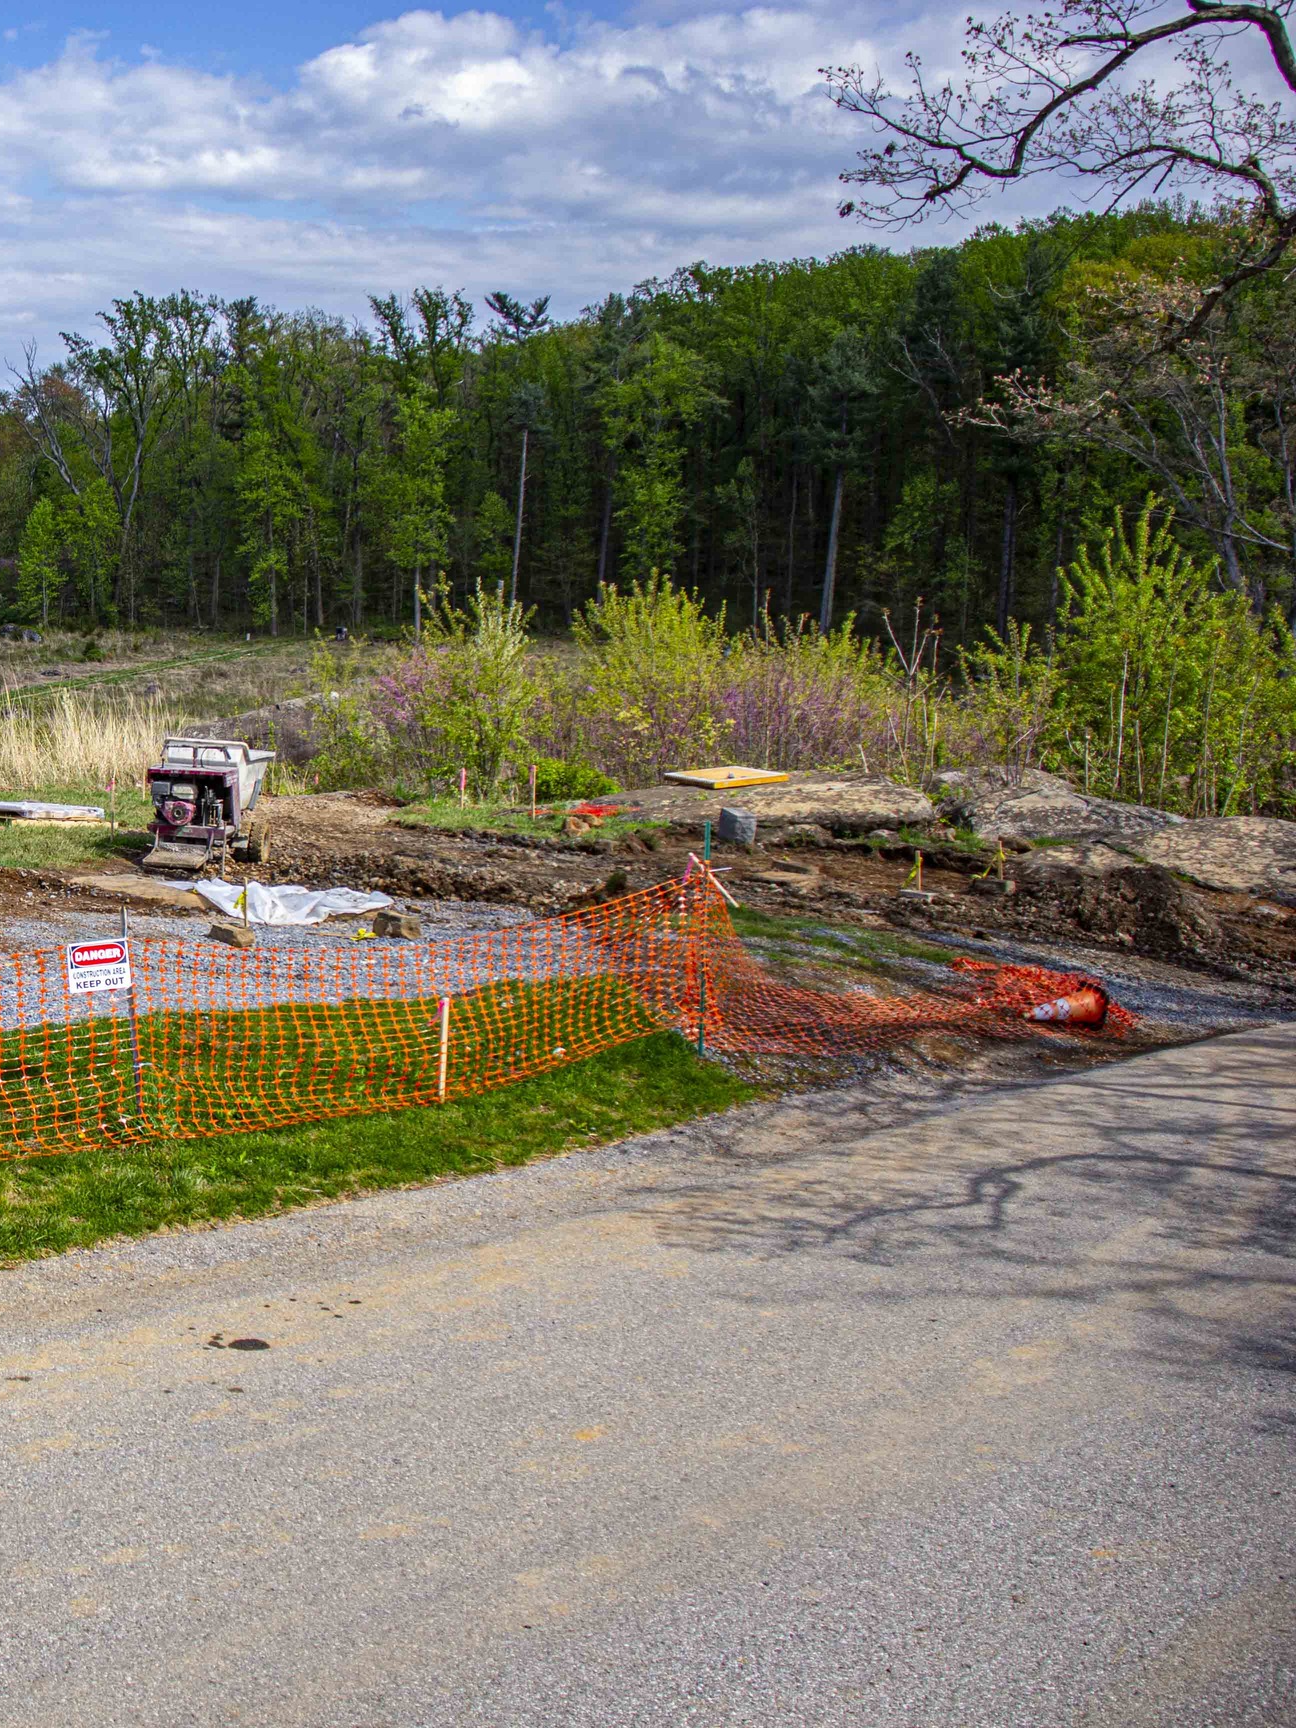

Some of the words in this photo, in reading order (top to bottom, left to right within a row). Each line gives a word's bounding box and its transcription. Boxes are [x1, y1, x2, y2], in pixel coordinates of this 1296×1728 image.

[75, 948, 121, 962] DANGER
[73, 969, 111, 979] CONSTRUCTION
[113, 967, 126, 975] AREA
[76, 979, 101, 989] KEEP
[105, 977, 124, 986] OUT
